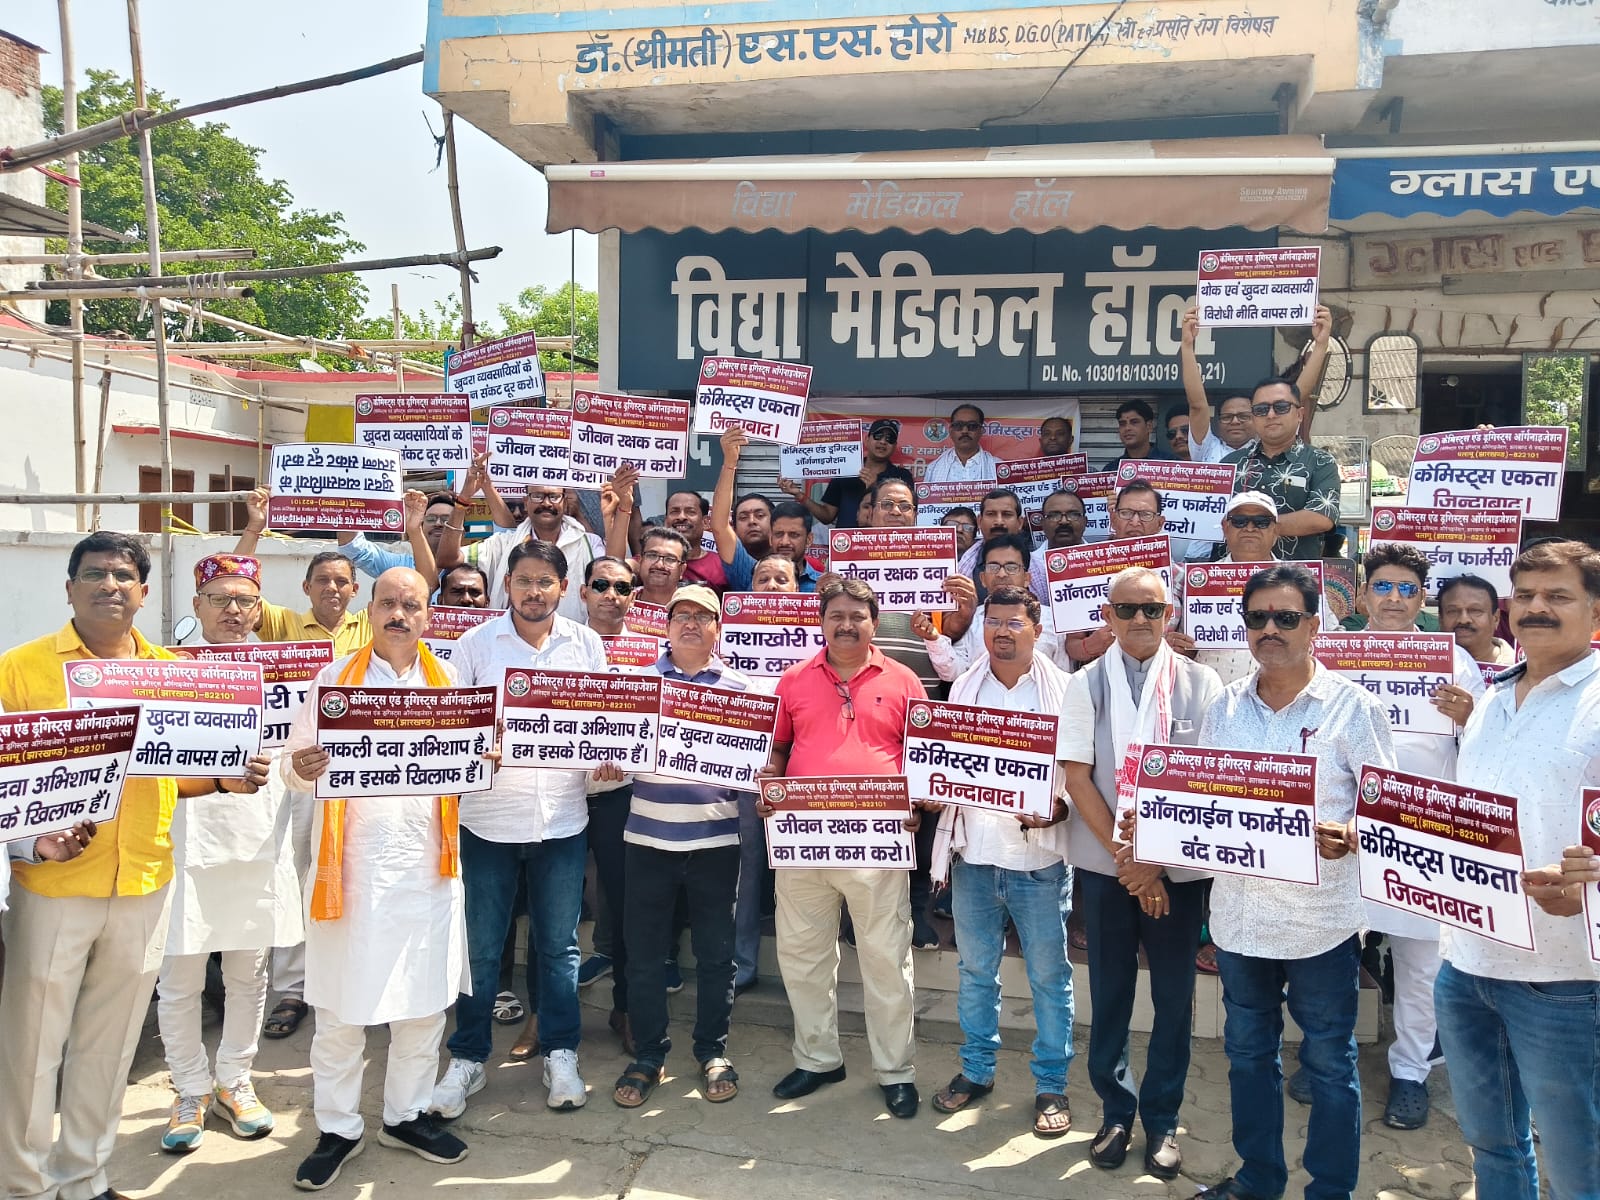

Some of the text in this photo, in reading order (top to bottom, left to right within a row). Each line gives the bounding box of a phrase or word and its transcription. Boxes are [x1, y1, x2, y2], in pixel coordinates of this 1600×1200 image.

[889, 13, 957, 61] होरो
[1193, 13, 1224, 37] रोग
[1226, 12, 1280, 39] विशेषज्ञ
[1389, 167, 1538, 197] ग्लास
[845, 179, 964, 220] मेडिकल
[1008, 178, 1075, 222] हॉल
[1201, 279, 1314, 300] थोक एवं खुदरा व्यवसायी
[671, 245, 1215, 359] विद्या मेडिकल हॉल
[1204, 305, 1234, 320] विरोधी
[1236, 304, 1259, 319] नीति
[1260, 307, 1288, 319] वापस
[454, 360, 532, 392] खुदरा व्यवसायियों के
[1042, 363, 1178, 382] DL No. 103018/103019
[481, 384, 502, 399] संकट
[504, 382, 516, 398] दूर
[700, 387, 801, 418] केमिस्ट्स एकता
[393, 425, 463, 441] व्यवसायियों के
[578, 425, 679, 451] जीवन रक्षक दवा
[427, 448, 440, 466] दूर
[496, 437, 535, 457] जीवन
[573, 451, 590, 465] का
[594, 453, 617, 468] दाम
[490, 464, 568, 481] का दाम कम
[1414, 462, 1558, 490] केमिस्ट्स एकता
[1183, 496, 1226, 514] फार्मेसी
[1458, 547, 1514, 566] फार्मेसी
[884, 567, 949, 581] रक्षक दवा
[889, 591, 916, 604] कम
[1189, 598, 1213, 615] थोक
[1216, 598, 1235, 616] एवं
[725, 627, 808, 647] नशाखोरी
[1194, 625, 1229, 642] विरोधी
[147, 663, 160, 677] एंड
[389, 691, 401, 707] एंड
[14, 718, 30, 738] एंड
[146, 707, 258, 735] खुदरा व्यवसायी
[506, 713, 550, 734] नकली
[553, 720, 578, 735] दवा
[580, 715, 636, 737] अभिशाप
[322, 735, 470, 758] नकली दवा अभिशाप
[660, 722, 768, 753] एवं खुदरा व्यवसायी
[136, 741, 171, 766] नीति
[176, 749, 218, 767] वापस
[512, 744, 536, 759] हम
[538, 741, 575, 760] इसके
[578, 740, 627, 761] खिलाफ
[1203, 751, 1216, 769] एंड
[669, 752, 698, 773] नीति
[700, 761, 734, 778] वापस
[909, 742, 1050, 781] केमिस्ट्स एकता
[32, 766, 102, 794] अभिशाप
[329, 769, 356, 788] हम
[359, 765, 402, 787] इसके
[405, 763, 462, 785] खिलाफ
[929, 772, 1025, 810] जिन्दाबाद।
[1413, 781, 1425, 800] एंड
[24, 799, 87, 827] खिलाफ
[776, 813, 902, 834] जीवन रक्षक दवा
[1140, 795, 1312, 837] ऑनलाईन फार्मेसी
[773, 846, 795, 861] का
[799, 846, 830, 861] दाम
[835, 845, 866, 861] कम
[1181, 835, 1210, 862] बंद
[1359, 824, 1518, 894] केमिस्ट्स एकता
[1384, 868, 1495, 932] जिन्दाबाद।
